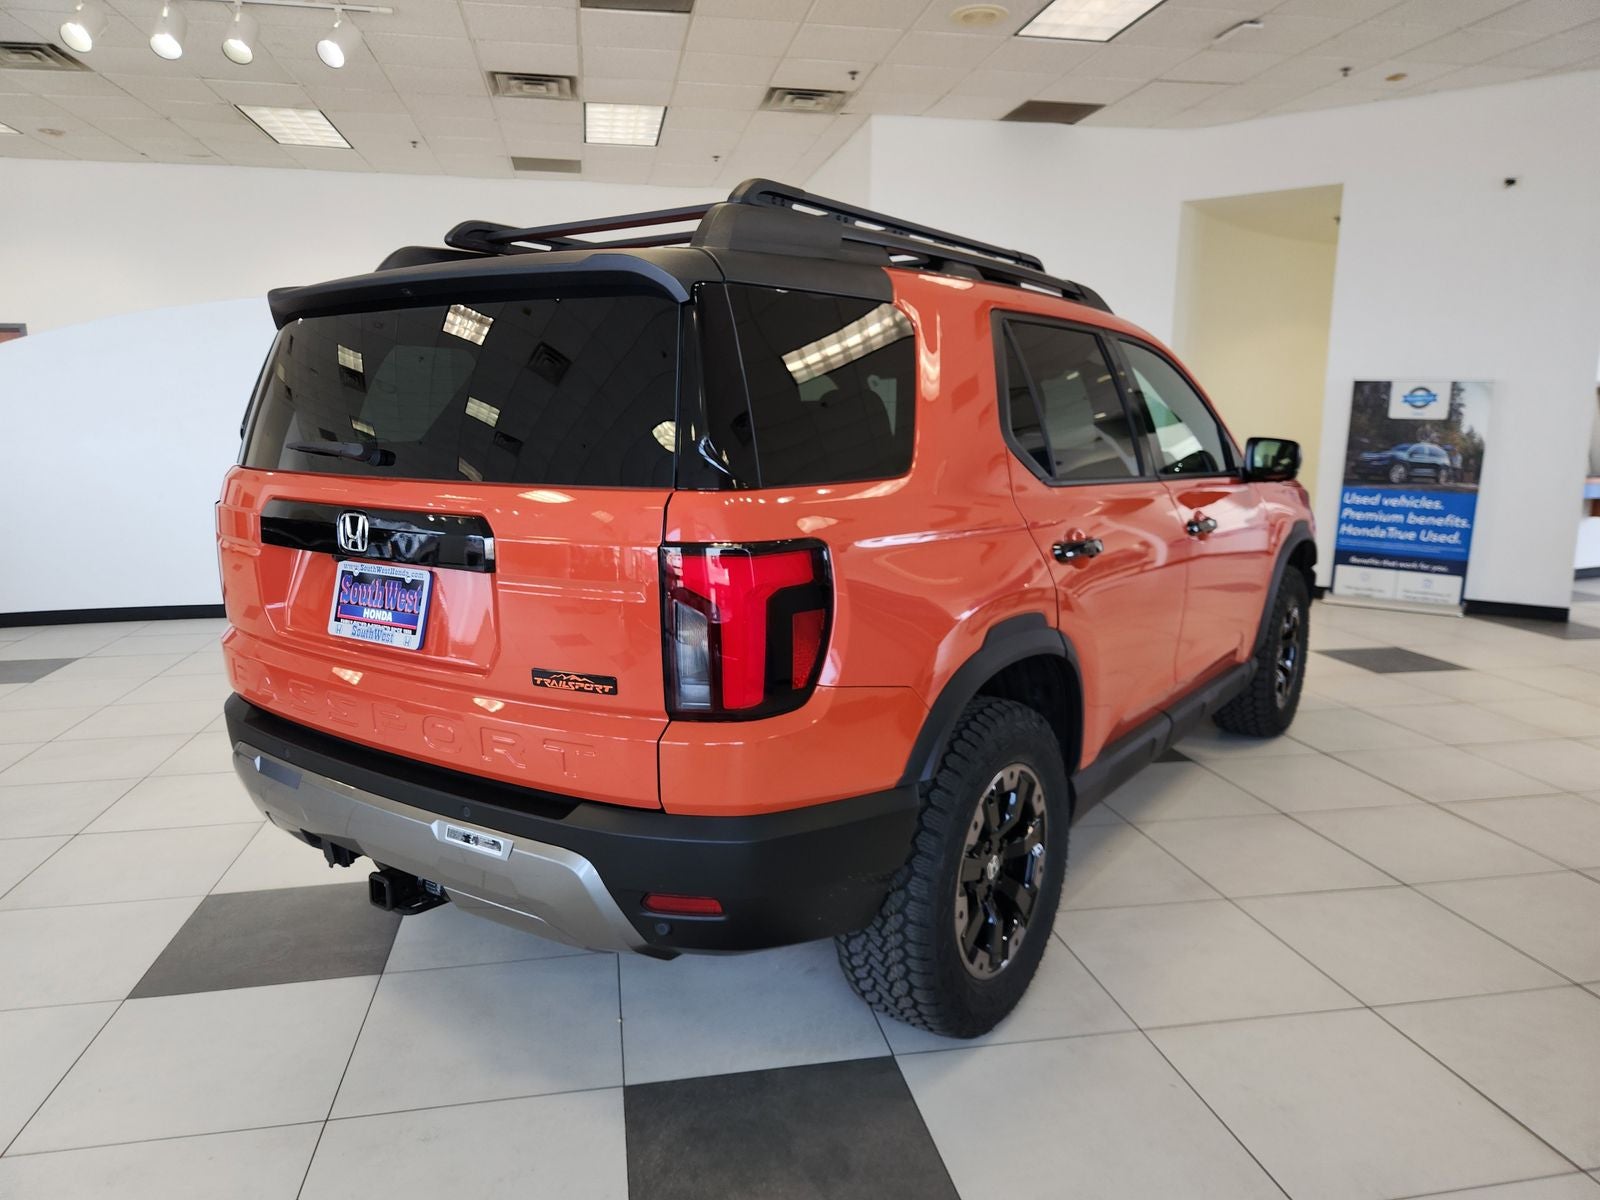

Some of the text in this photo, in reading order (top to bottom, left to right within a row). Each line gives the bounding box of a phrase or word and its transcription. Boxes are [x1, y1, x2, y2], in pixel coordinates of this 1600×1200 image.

[1343, 492, 1445, 511] Used vehicles.
[1341, 507, 1472, 529] Premium benefits.
[1419, 529, 1462, 545] Used.
[363, 608, 393, 622] HONDA
[534, 677, 614, 694] TRAILSPORT
